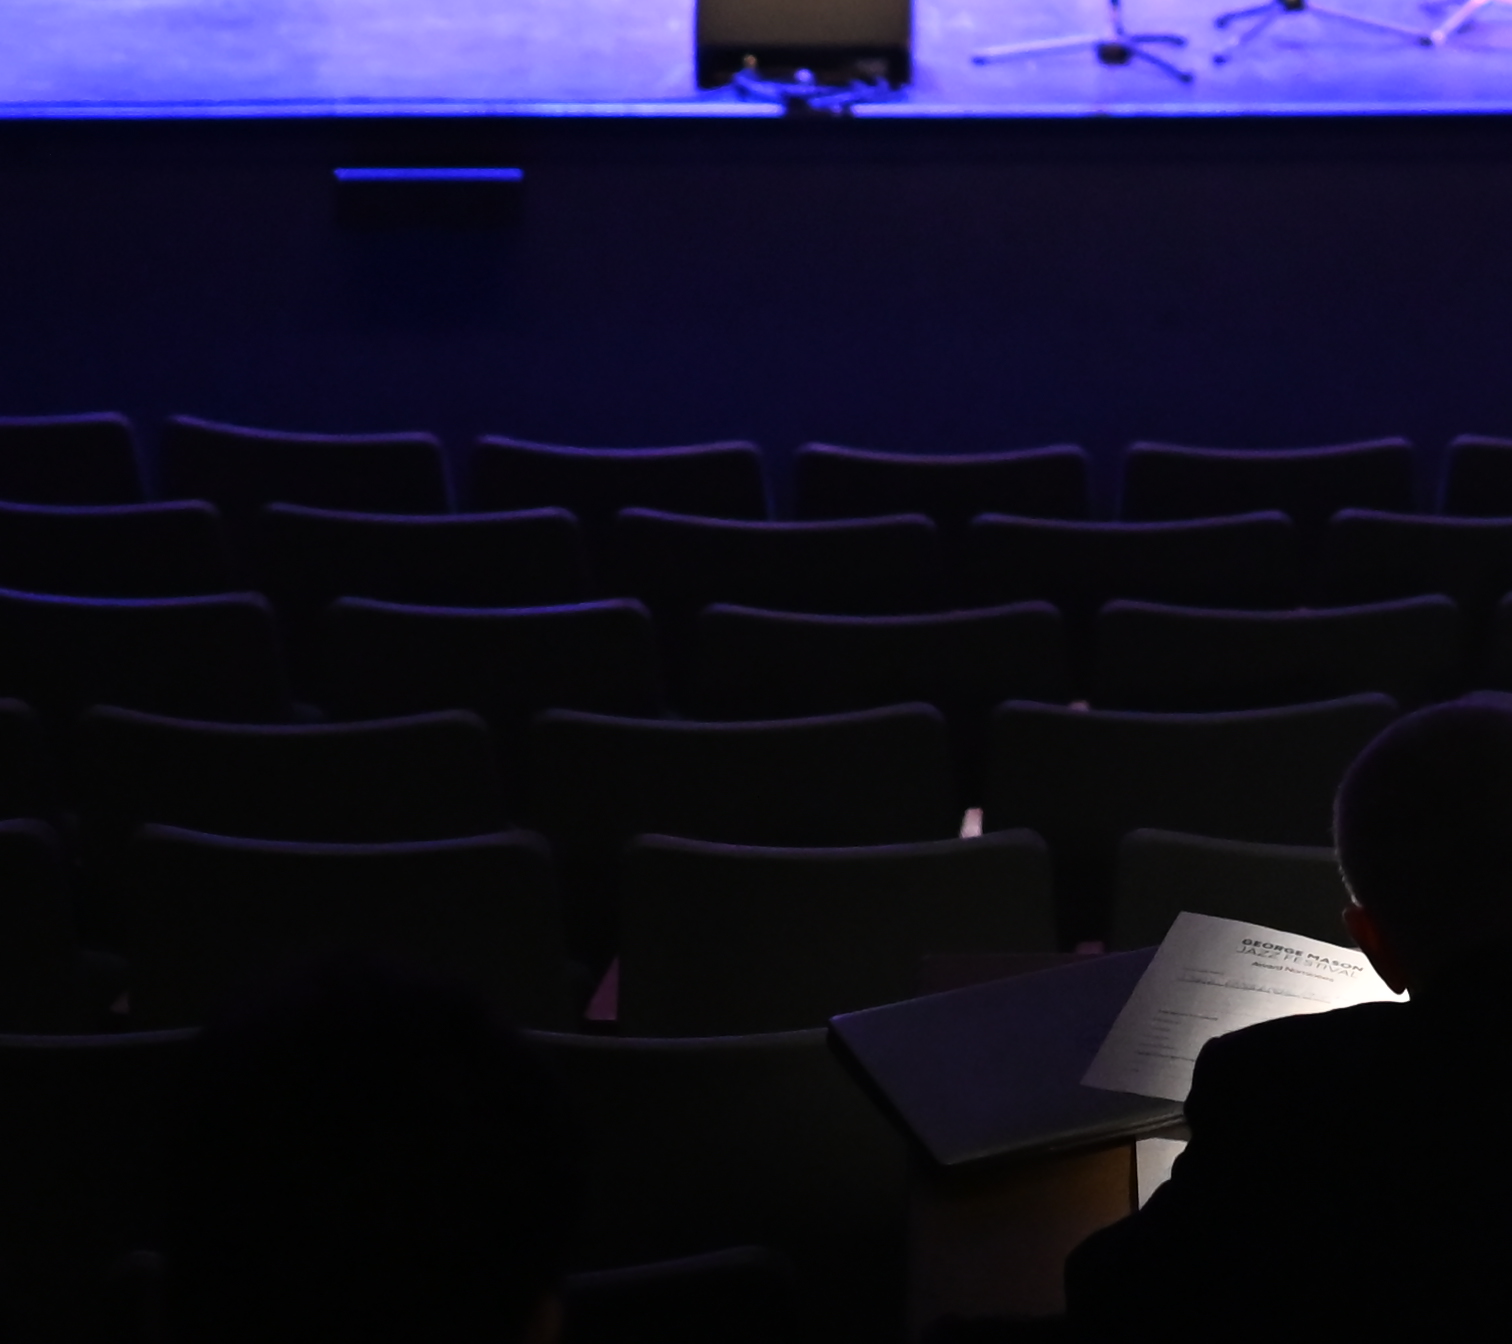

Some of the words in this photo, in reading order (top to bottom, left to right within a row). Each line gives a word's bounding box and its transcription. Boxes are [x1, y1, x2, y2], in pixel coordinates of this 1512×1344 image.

[1236, 946, 1281, 959] JAZZ
[1283, 954, 1357, 978] FESTIVAL
[1241, 938, 1304, 957] GEORGE
[1307, 953, 1364, 972] MASON
